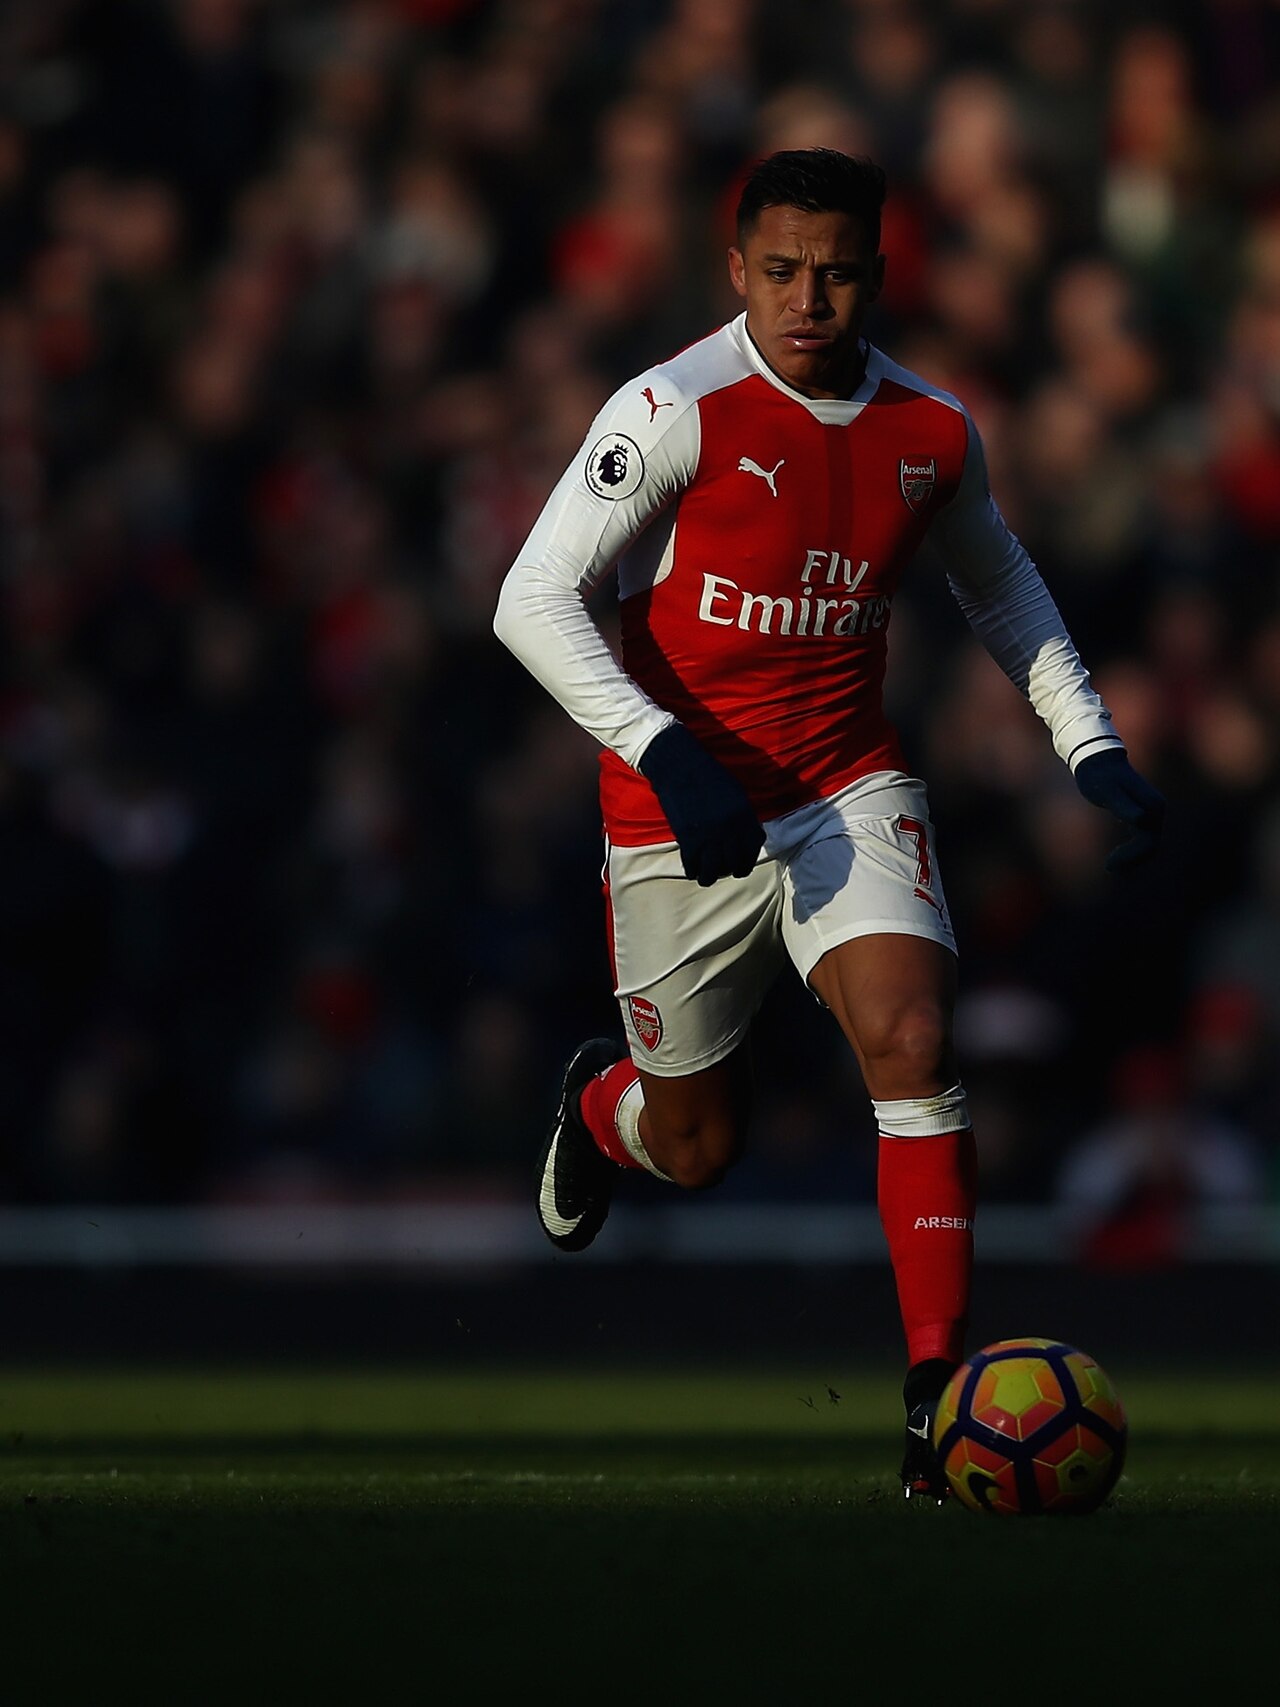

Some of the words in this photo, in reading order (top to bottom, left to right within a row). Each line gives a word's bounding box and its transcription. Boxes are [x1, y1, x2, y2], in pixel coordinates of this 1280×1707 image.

[903, 464, 933, 475] Arsenal
[801, 549, 869, 593] Fly
[897, 815, 932, 890] 7
